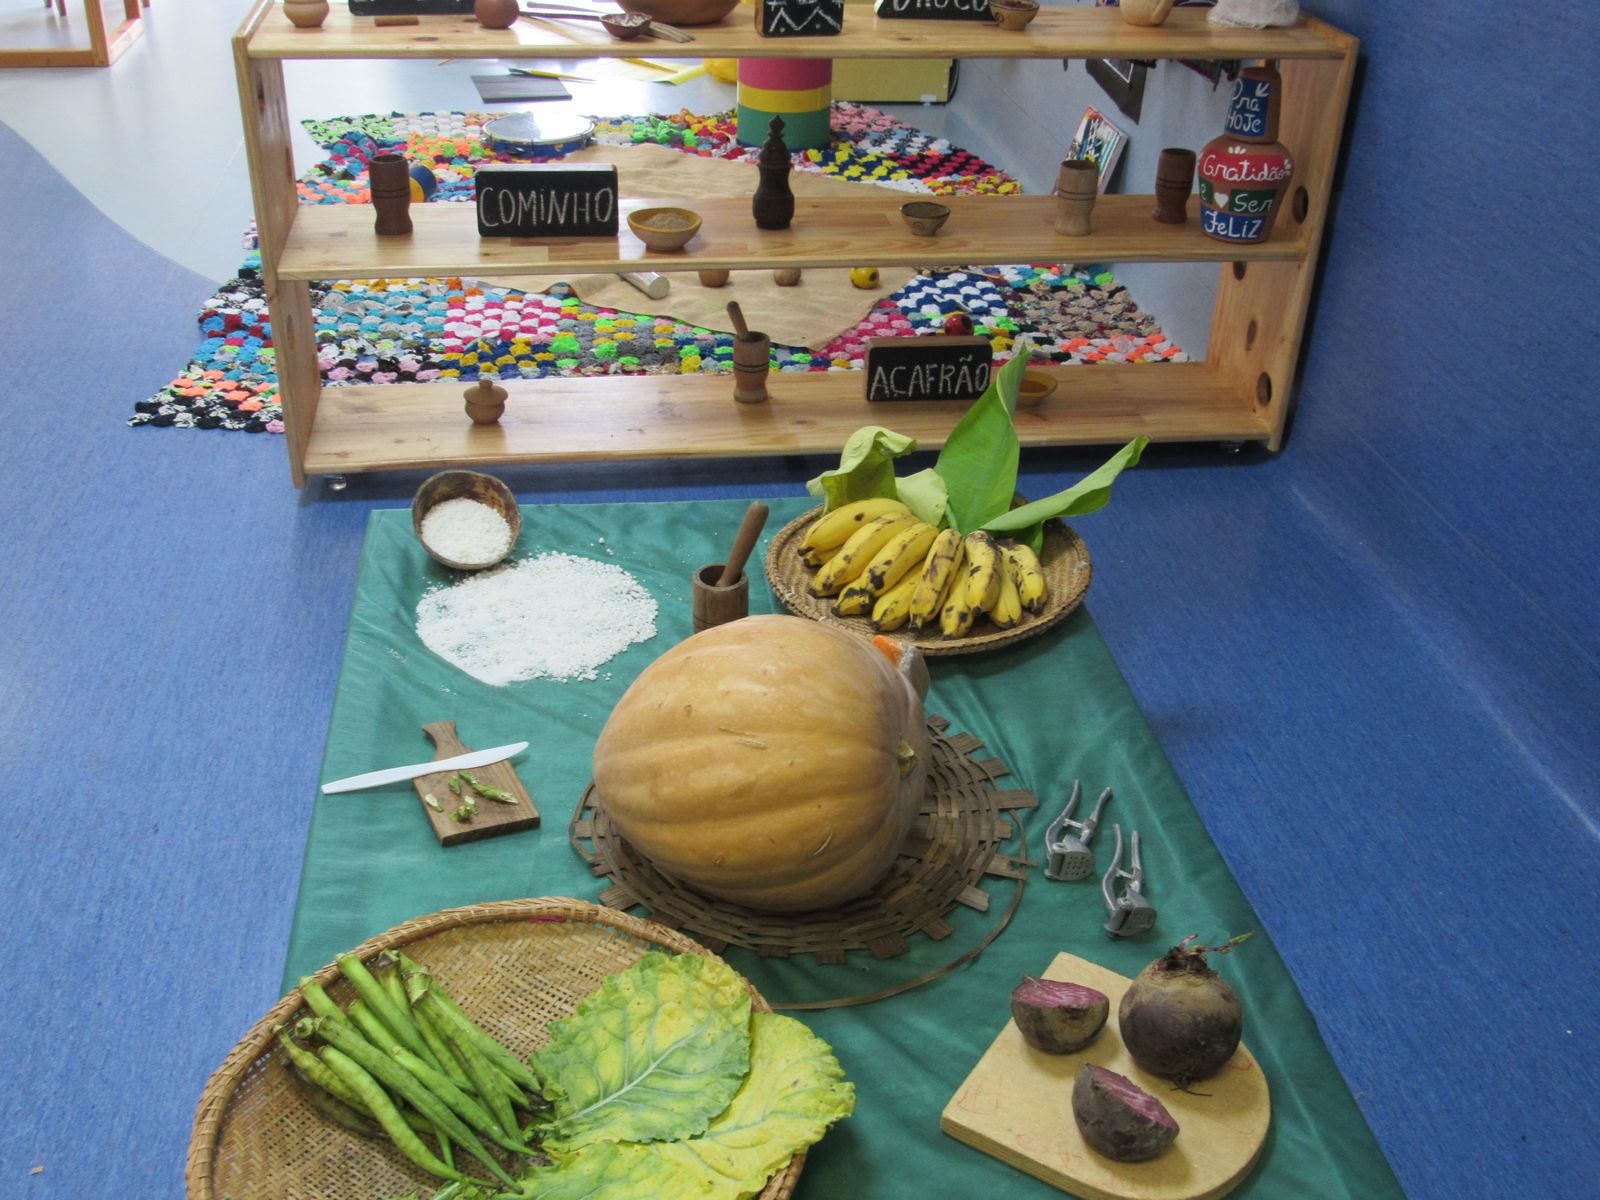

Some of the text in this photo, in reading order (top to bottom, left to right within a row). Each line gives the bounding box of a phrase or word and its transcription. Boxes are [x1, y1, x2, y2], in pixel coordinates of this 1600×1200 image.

[1203, 155, 1284, 181] Gratidão
[1233, 193, 1273, 213] Ser
[870, 354, 989, 400] AÇAFRÃO
